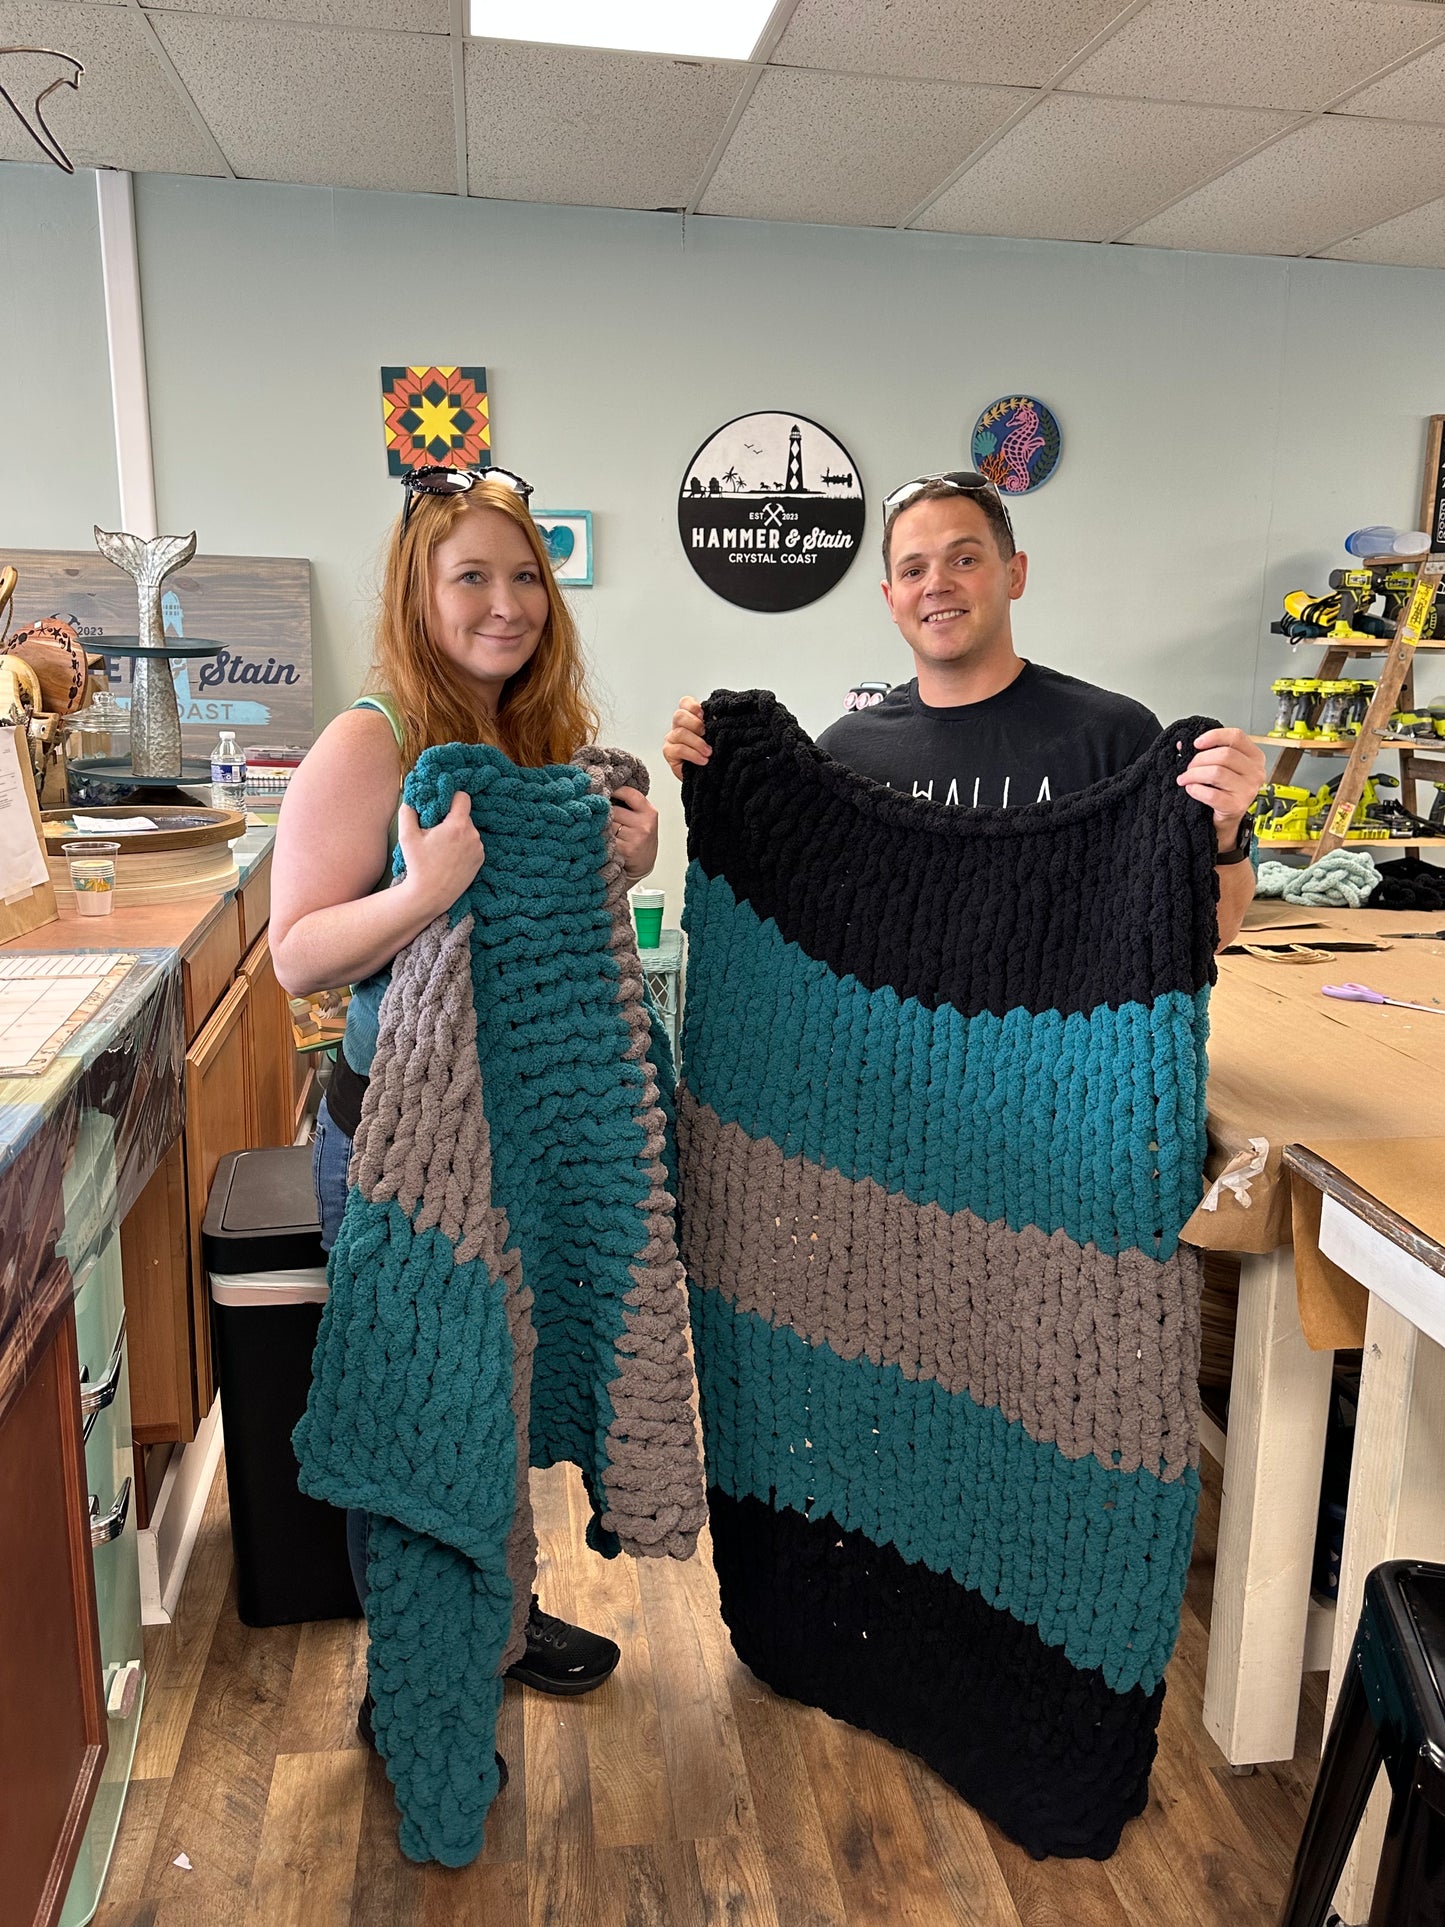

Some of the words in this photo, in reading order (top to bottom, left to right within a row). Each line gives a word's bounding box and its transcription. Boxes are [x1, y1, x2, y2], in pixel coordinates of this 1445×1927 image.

[781, 512, 799, 521] 2023
[692, 527, 780, 549] HAMMER
[785, 528, 801, 548] &
[802, 527, 854, 553] Stain
[728, 553, 777, 564] CRYSTAL
[780, 553, 818, 564] COAST
[77, 626, 104, 636] 2023
[198, 651, 301, 692] Stain
